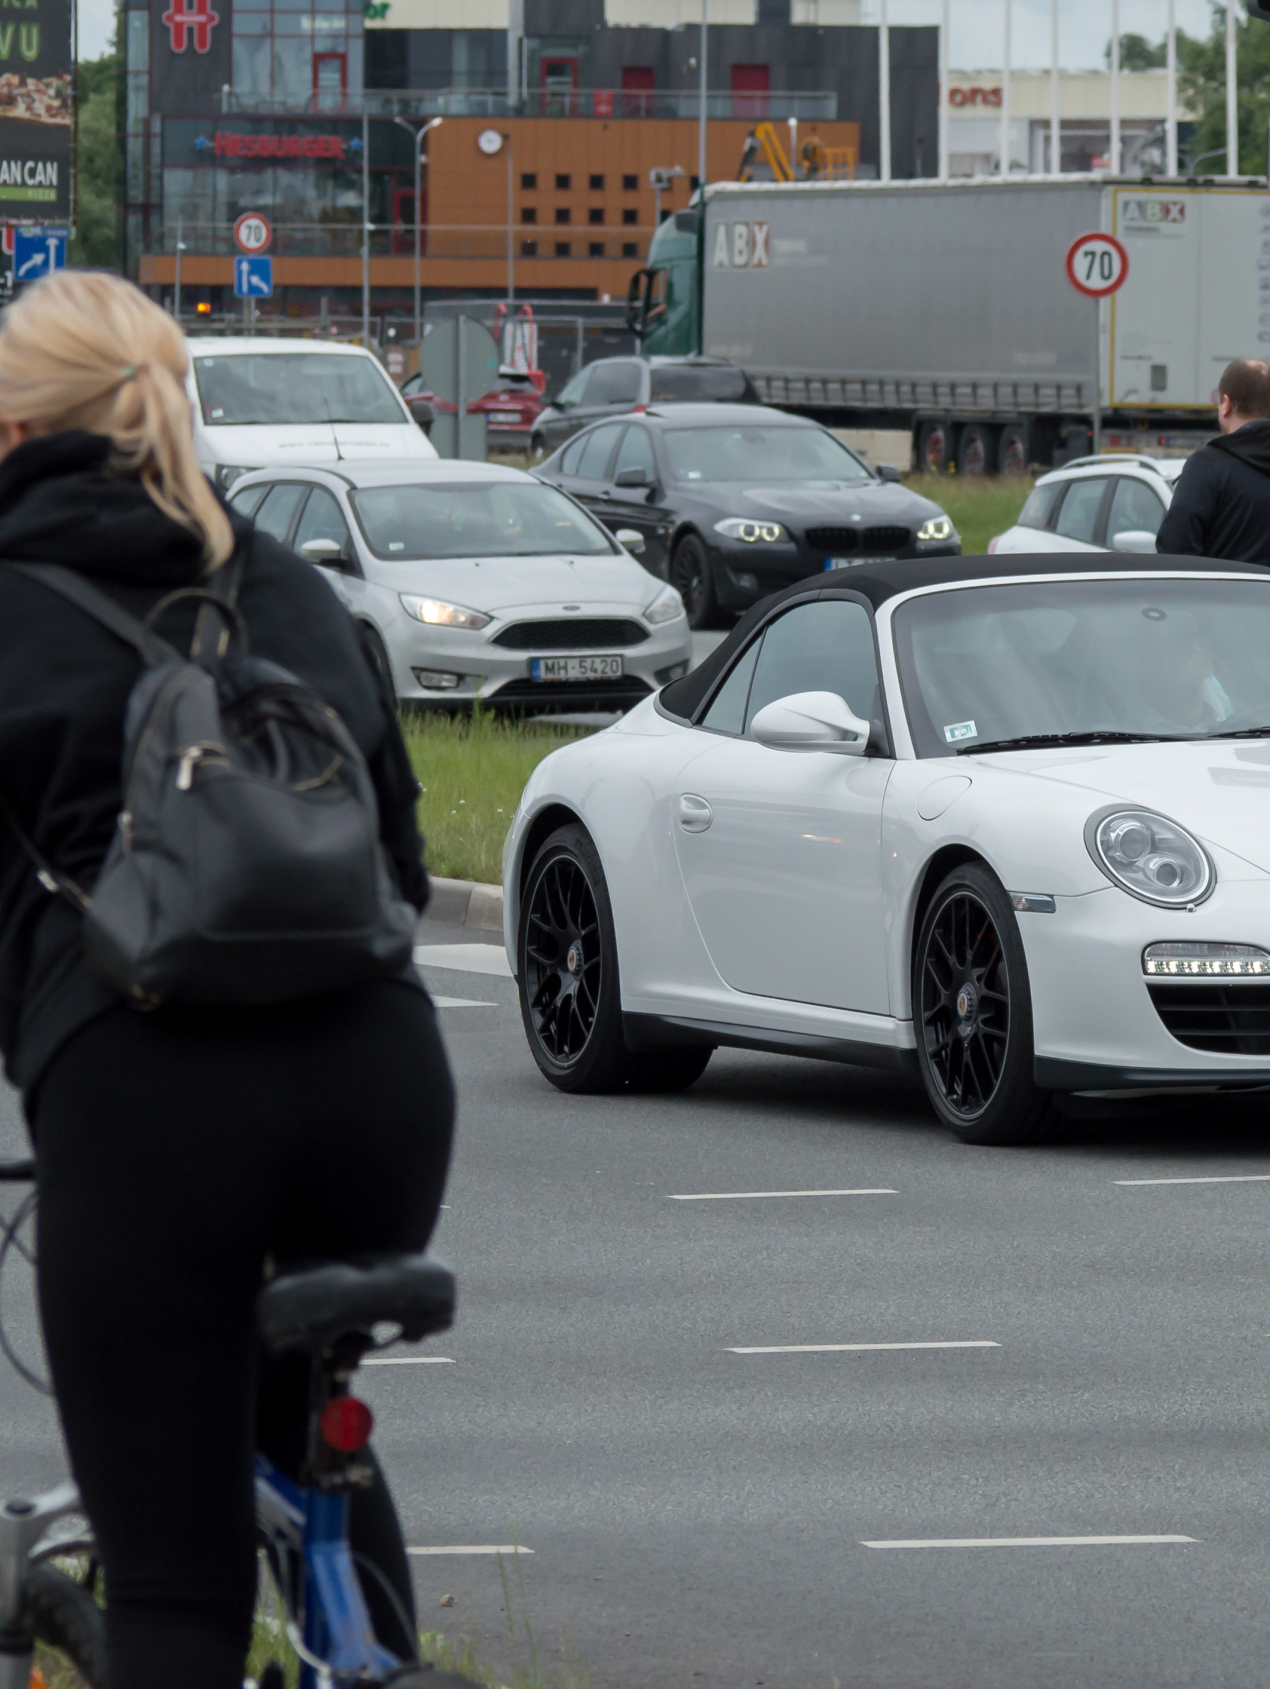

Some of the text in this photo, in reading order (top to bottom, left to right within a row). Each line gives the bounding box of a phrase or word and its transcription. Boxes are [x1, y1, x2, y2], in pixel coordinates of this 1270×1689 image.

[214, 132, 346, 160] HESBURGER
[1123, 201, 1186, 223] ABX
[245, 223, 262, 243] 70
[713, 222, 770, 268] ABX
[1084, 250, 1113, 281] 70
[544, 659, 619, 677] MH-5420
